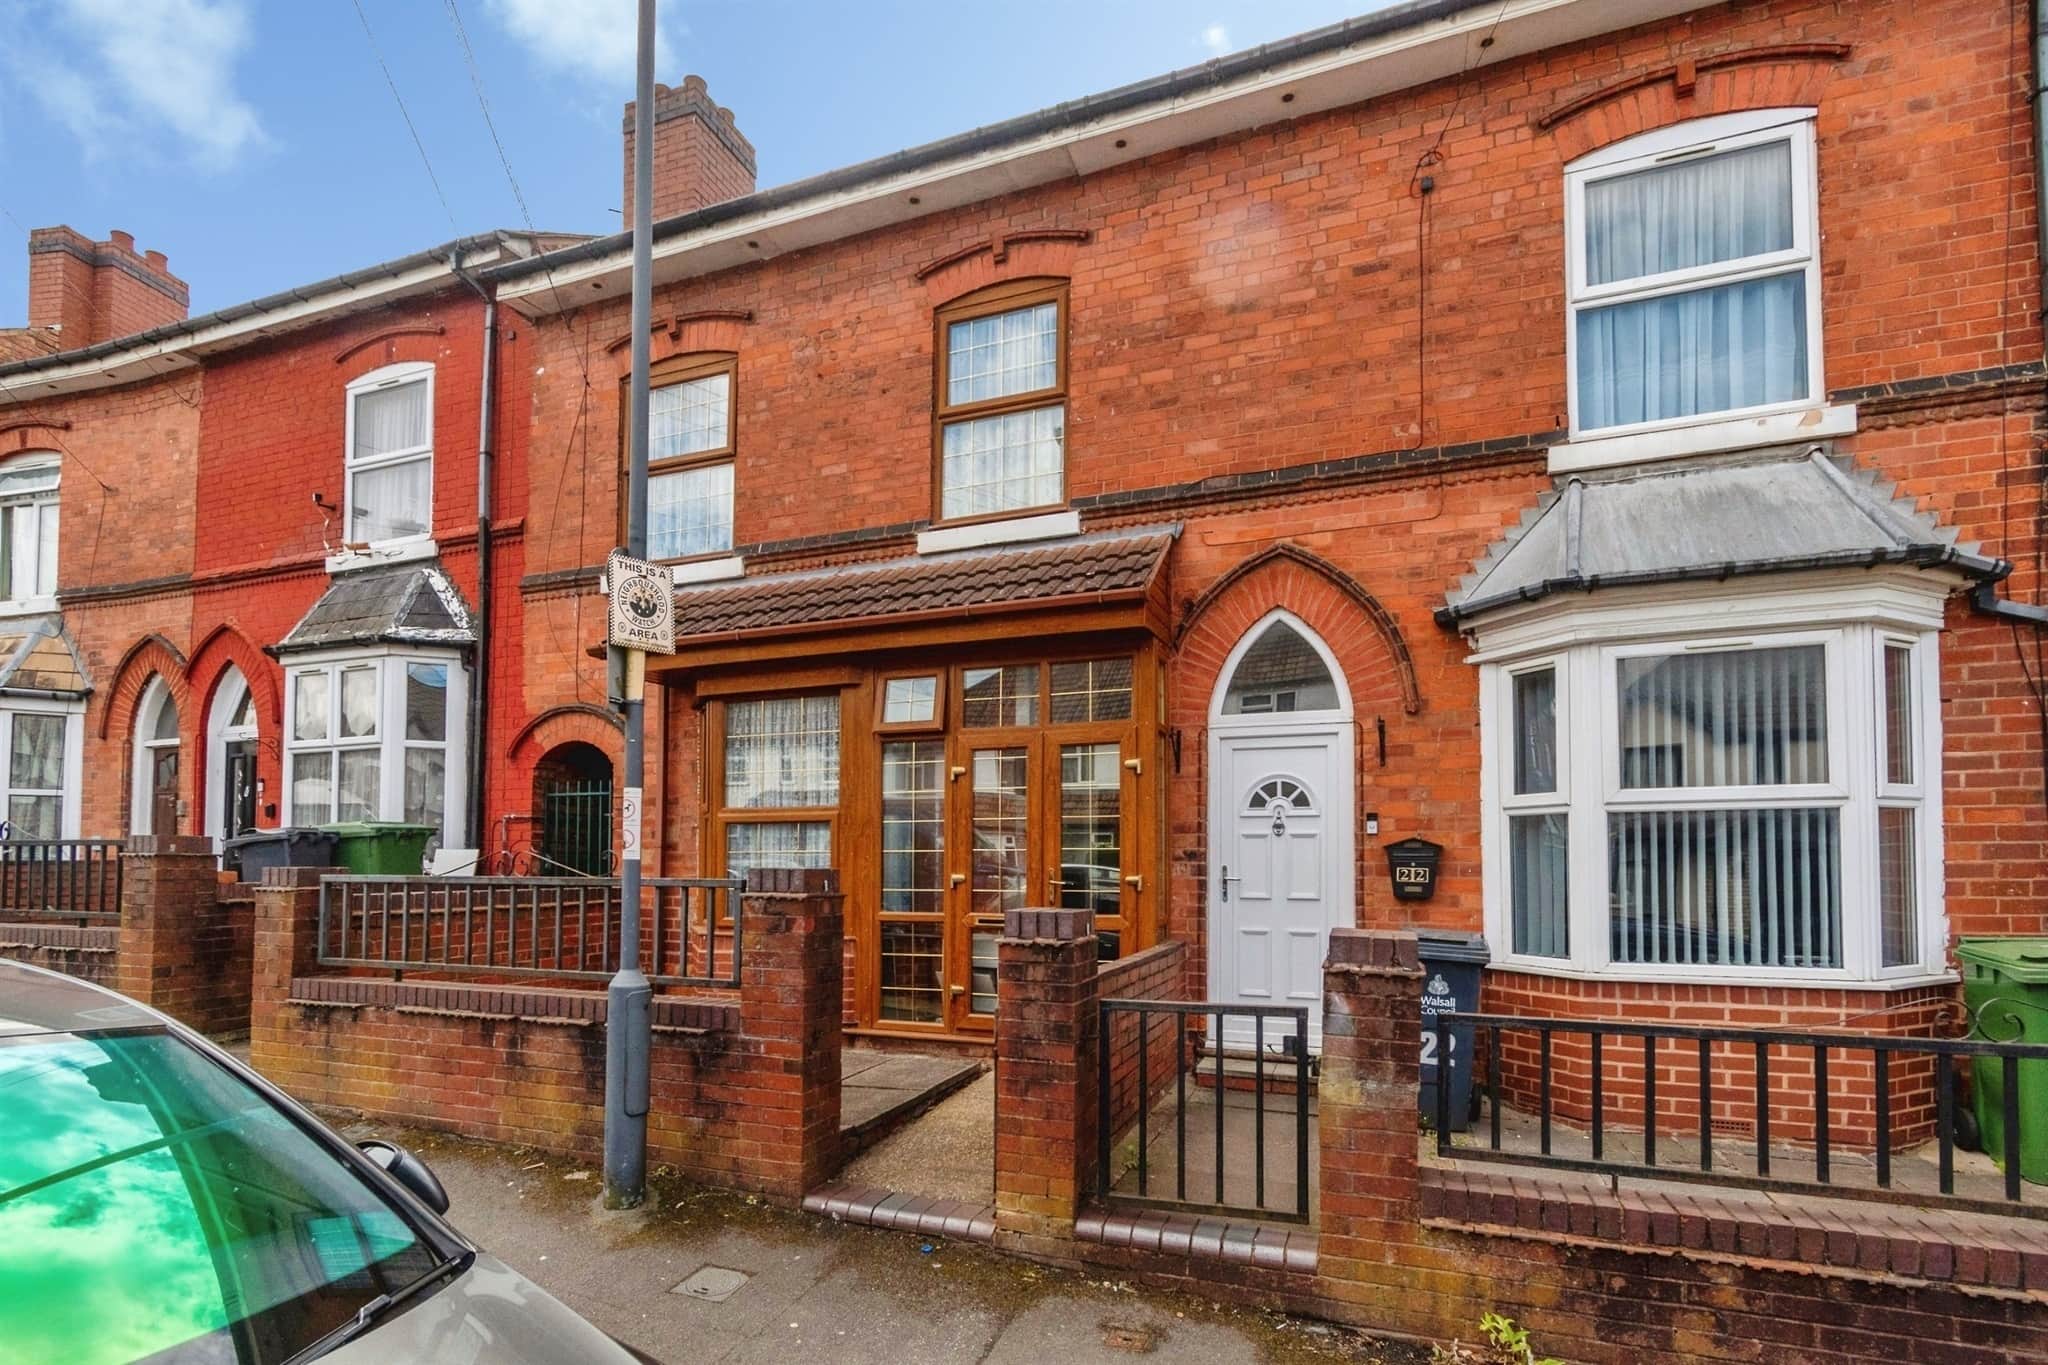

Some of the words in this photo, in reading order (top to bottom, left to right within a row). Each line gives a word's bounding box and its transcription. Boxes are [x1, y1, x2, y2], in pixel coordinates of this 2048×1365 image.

[617, 560, 642, 574] THIS
[646, 567, 656, 577] IS
[658, 570, 667, 580] A
[620, 579, 665, 614] NEIGHBOURHOOD
[631, 614, 656, 627] WATCH
[628, 628, 658, 641] AREA
[1400, 869, 1425, 881] 22
[1420, 995, 1456, 1008] Walsall
